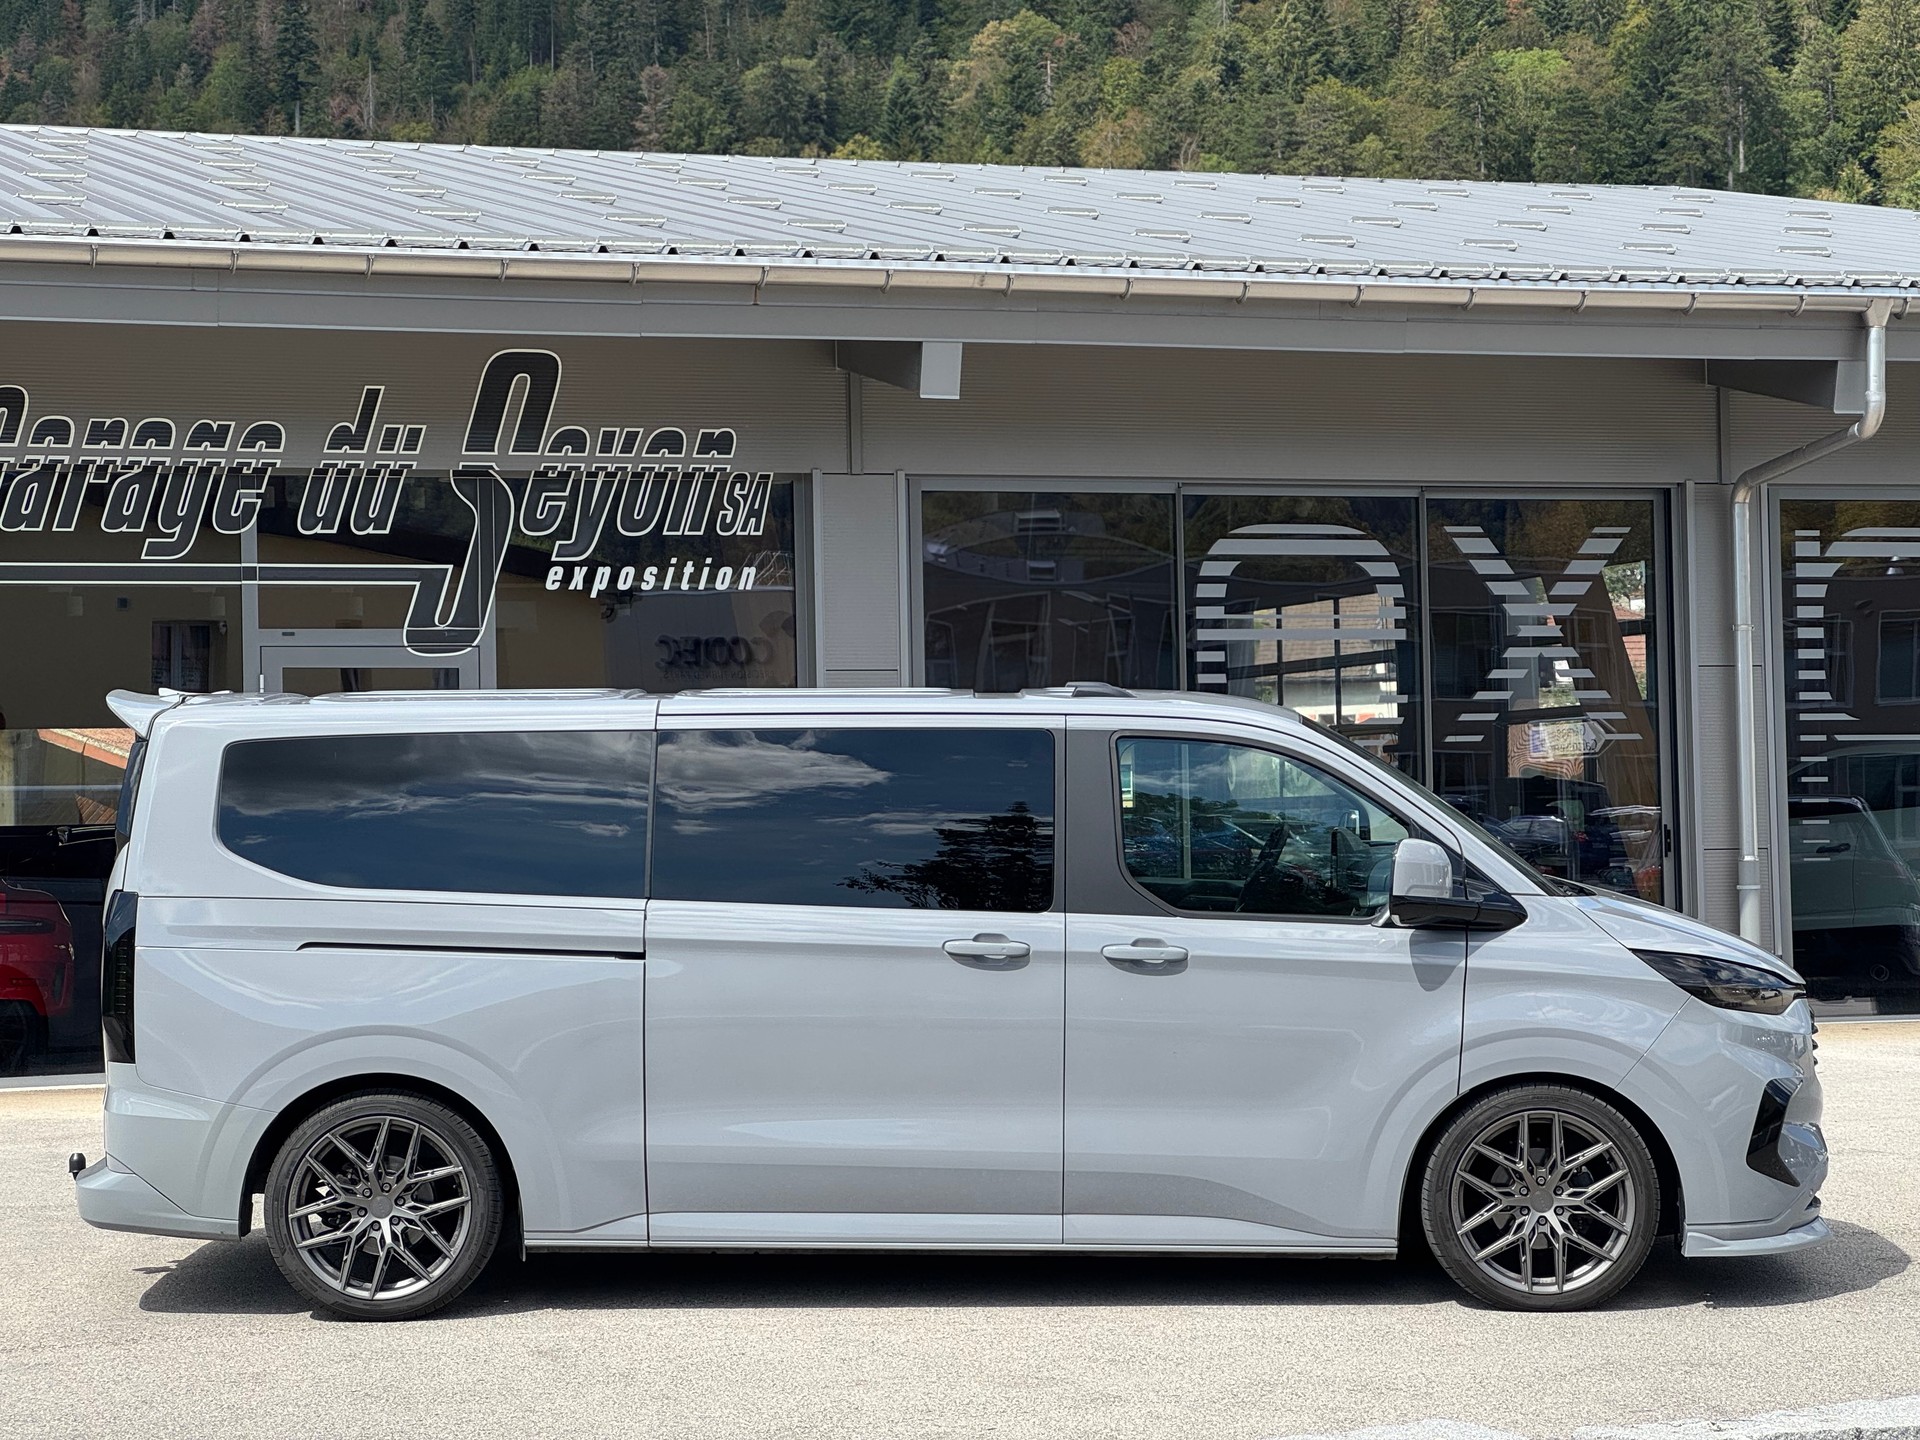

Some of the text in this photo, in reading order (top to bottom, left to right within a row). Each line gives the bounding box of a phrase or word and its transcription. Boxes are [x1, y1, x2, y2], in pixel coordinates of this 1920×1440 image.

[297, 385, 428, 536] du
[715, 471, 774, 536] SA
[545, 557, 757, 599] exposition
